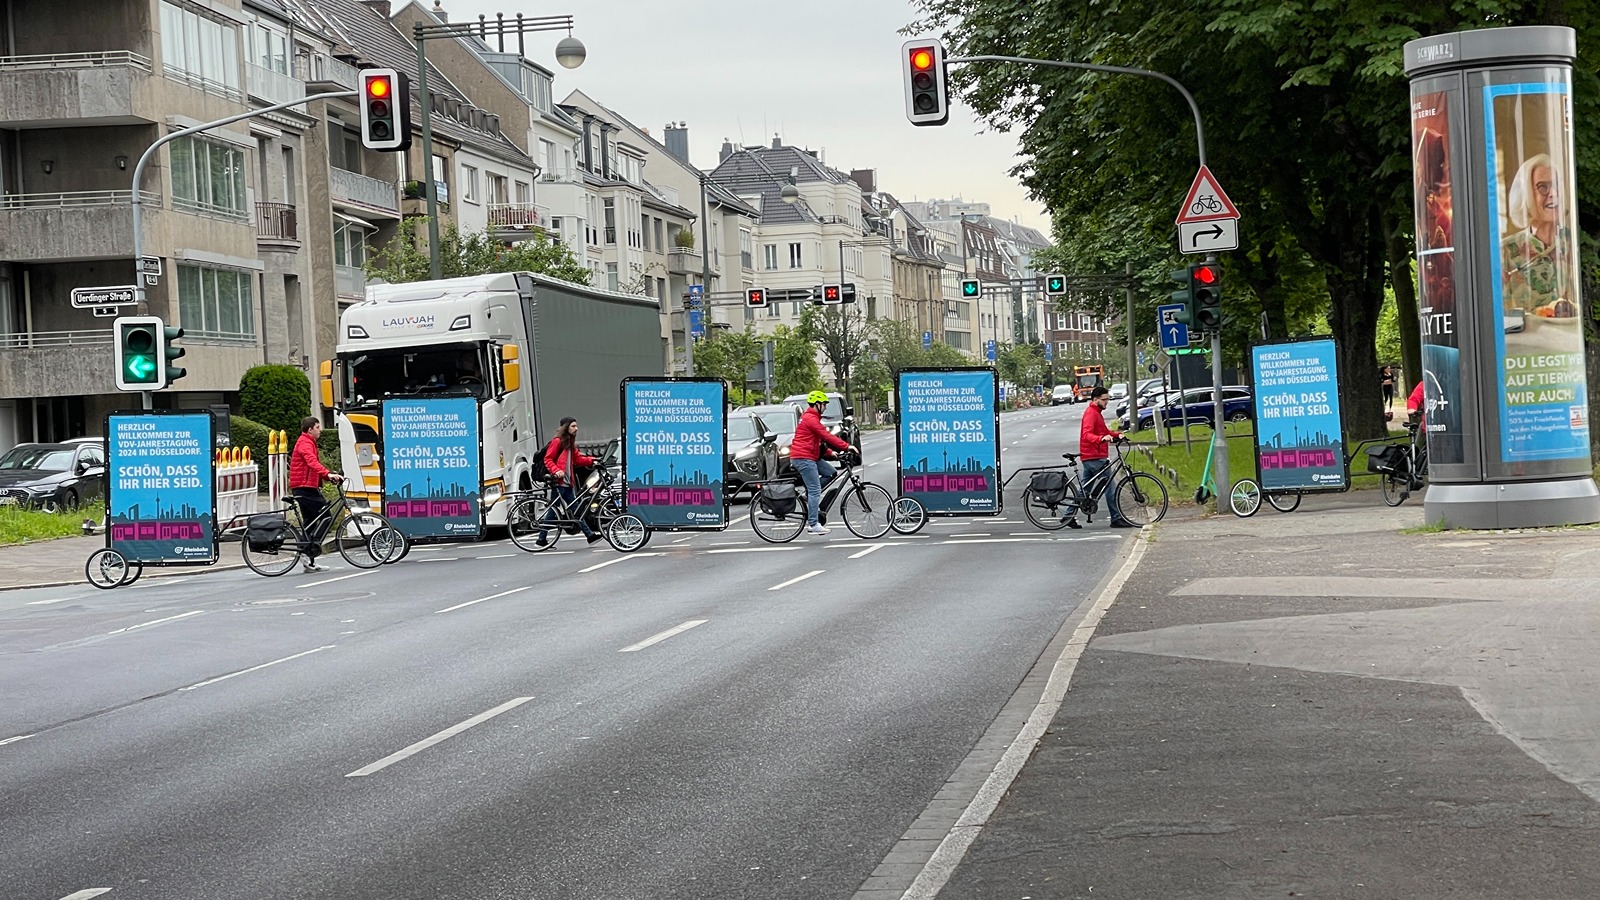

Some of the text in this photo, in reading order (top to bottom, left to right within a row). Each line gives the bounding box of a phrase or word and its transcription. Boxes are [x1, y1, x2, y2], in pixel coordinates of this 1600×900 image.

[1417, 44, 1449, 61] SCHWARZ
[1418, 109, 1435, 118] SERIE
[77, 292, 131, 303] Uerdinger Straße
[1260, 352, 1290, 360] HERZLICH
[1260, 360, 1305, 369] WILLKOMMEN
[1506, 358, 1526, 370] DU
[1531, 354, 1567, 368] LEGST
[1261, 366, 1326, 378] VDV-JAHRESTAGUNG
[1286, 375, 1330, 384] DÜSSELDORF.
[1506, 374, 1534, 387] AUF
[908, 396, 982, 404] VDV-JAHRESTAGUNG
[1263, 392, 1328, 406] SCHÖN, DASS
[1507, 389, 1574, 404] WIR AUCH.
[1264, 404, 1332, 418] IHR HIER SEID.
[665, 414, 714, 422] DÜSSELDORF.
[392, 422, 466, 430] VDV-JAHRESTAGUNG
[909, 419, 982, 432] SCHÖN, DASS
[118, 432, 172, 440] WILLKOMMEN
[636, 431, 710, 444] SCHÖN, DASS
[909, 432, 987, 443] IHR HIER SEID.
[118, 439, 198, 448] VDV-JAHRESTAGUNG
[636, 444, 715, 454] IHR HIER SEID.
[150, 447, 202, 456] DÜSSELDORF.
[393, 445, 465, 458] SCHÖN, DASS
[393, 458, 470, 469] IHR HIER SEID.
[119, 464, 197, 477] SCHÖN, DASS
[120, 477, 203, 489] IHR HIER SEID.
